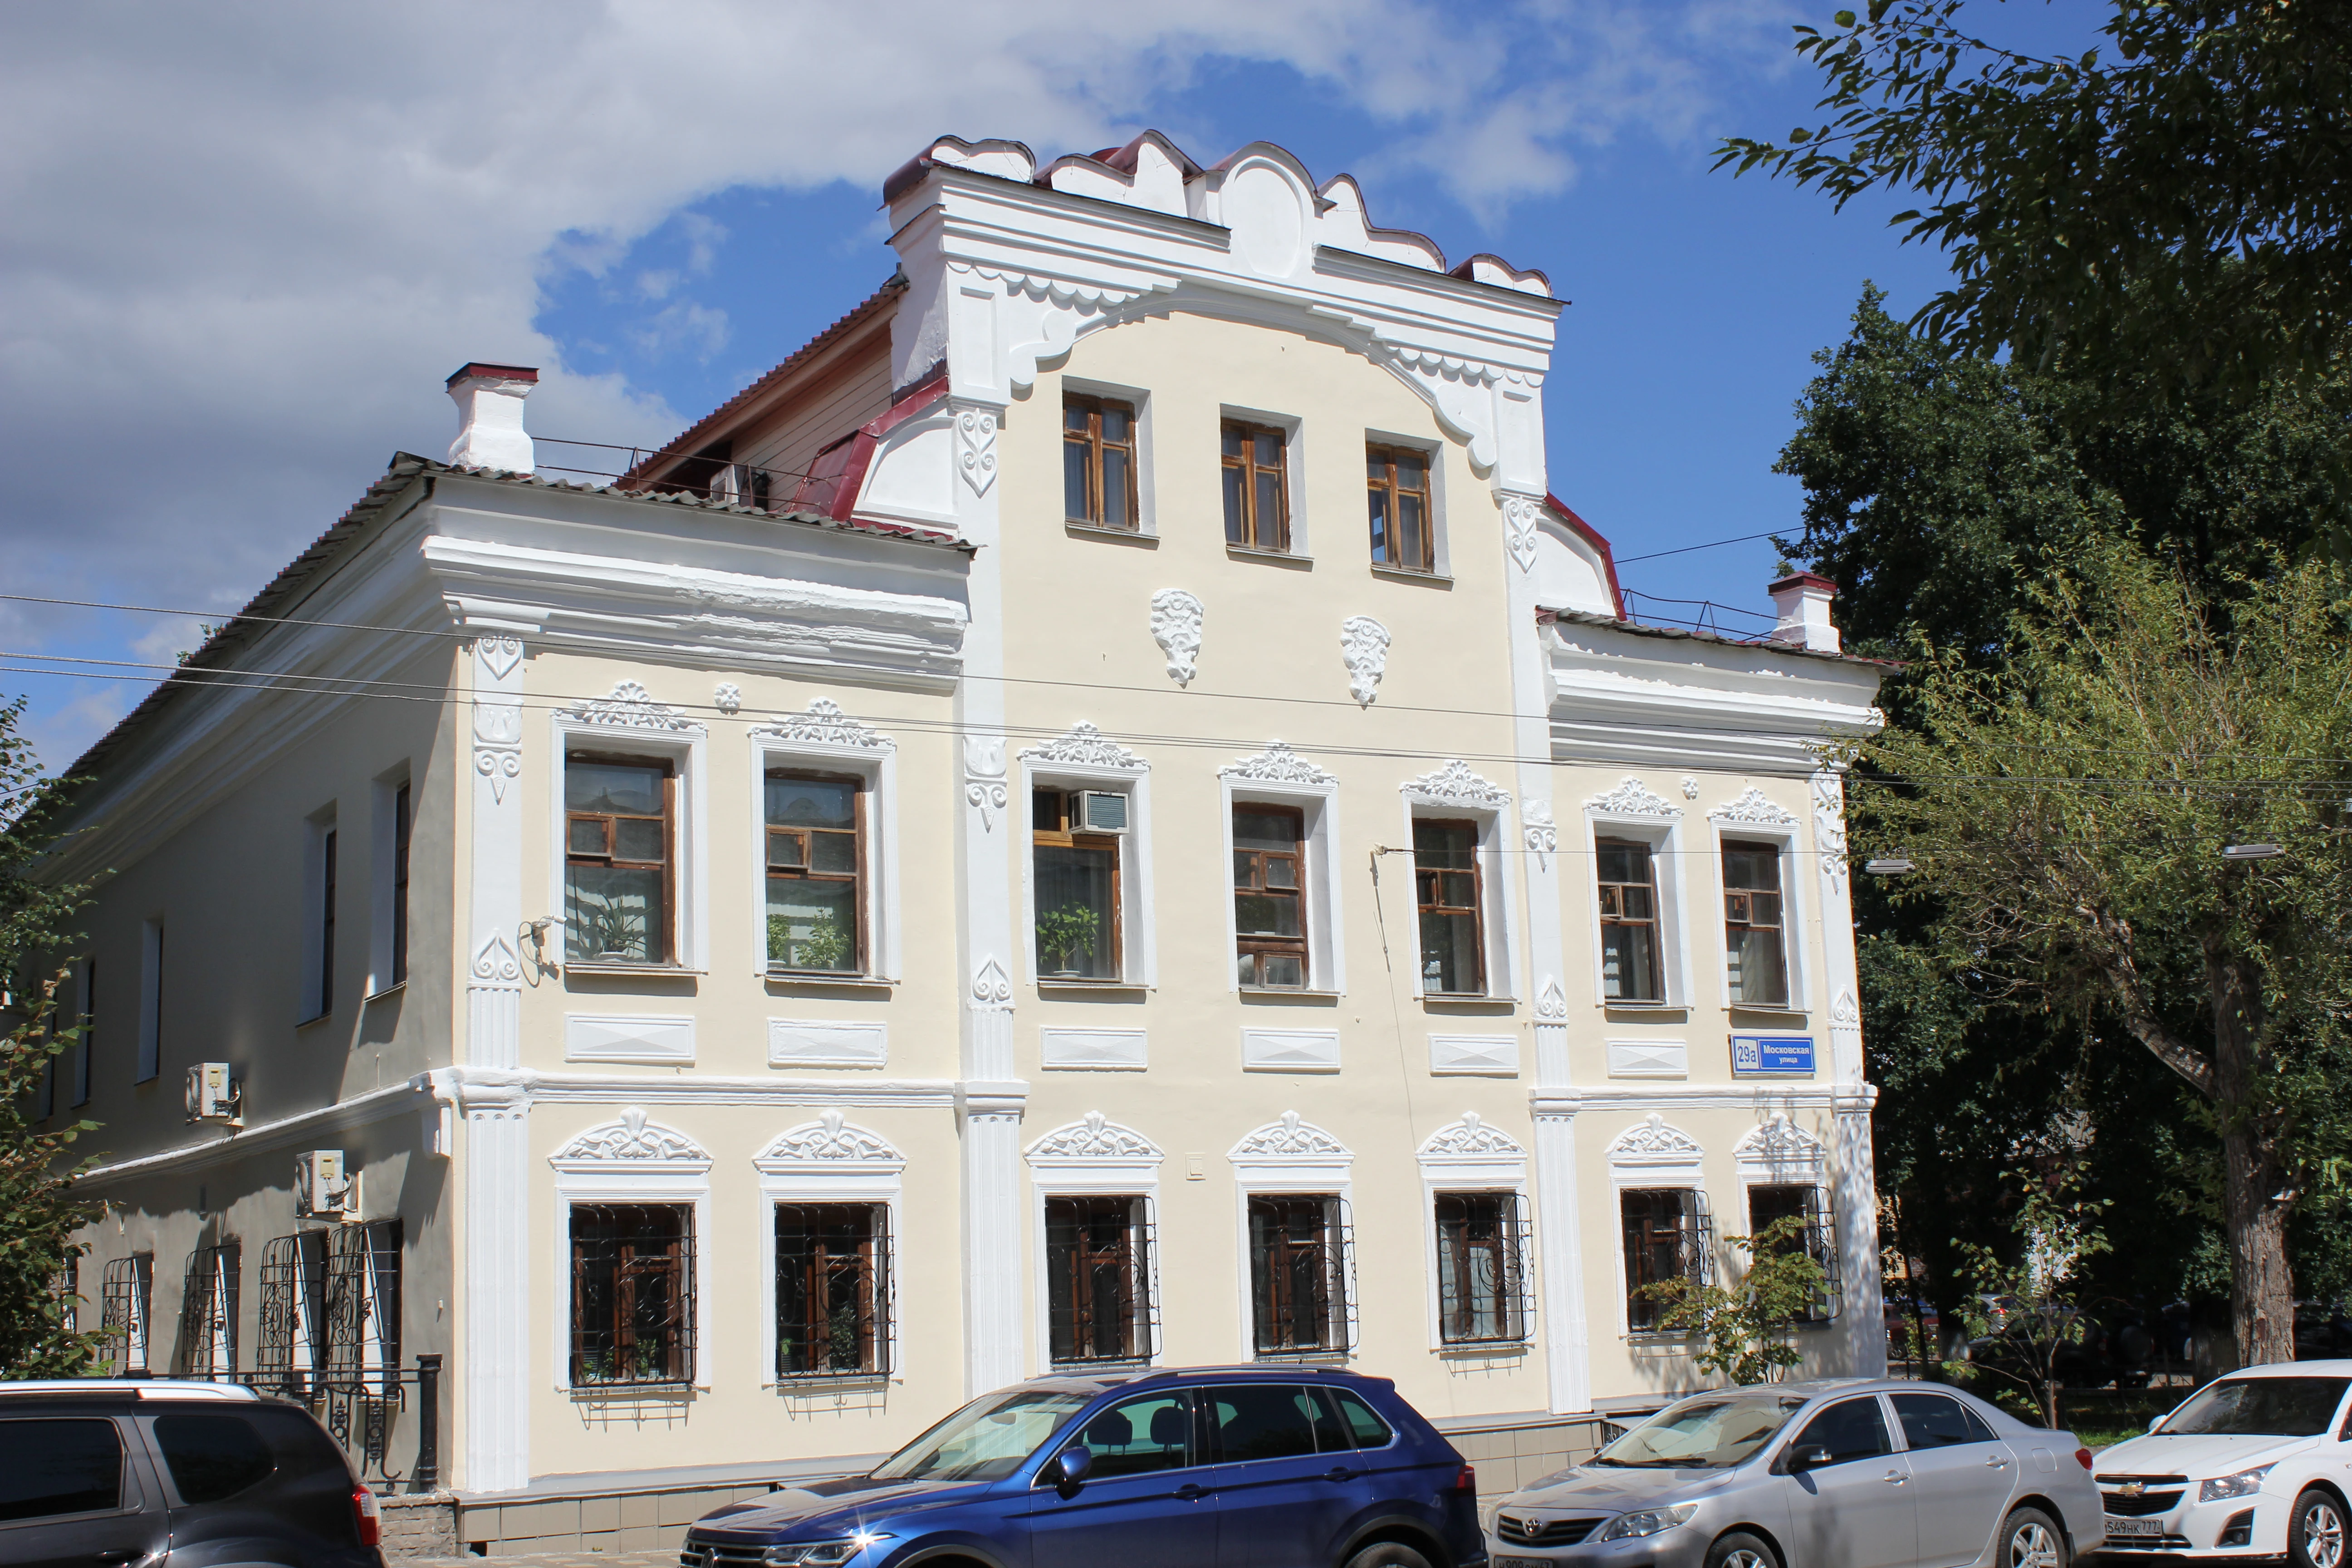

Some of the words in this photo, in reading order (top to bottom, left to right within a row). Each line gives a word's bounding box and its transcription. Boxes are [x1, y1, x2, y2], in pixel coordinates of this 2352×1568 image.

[1738, 1046, 1756, 1062] 29а
[1763, 1045, 1809, 1054] Московская
[2141, 1521, 2156, 1530] 777
